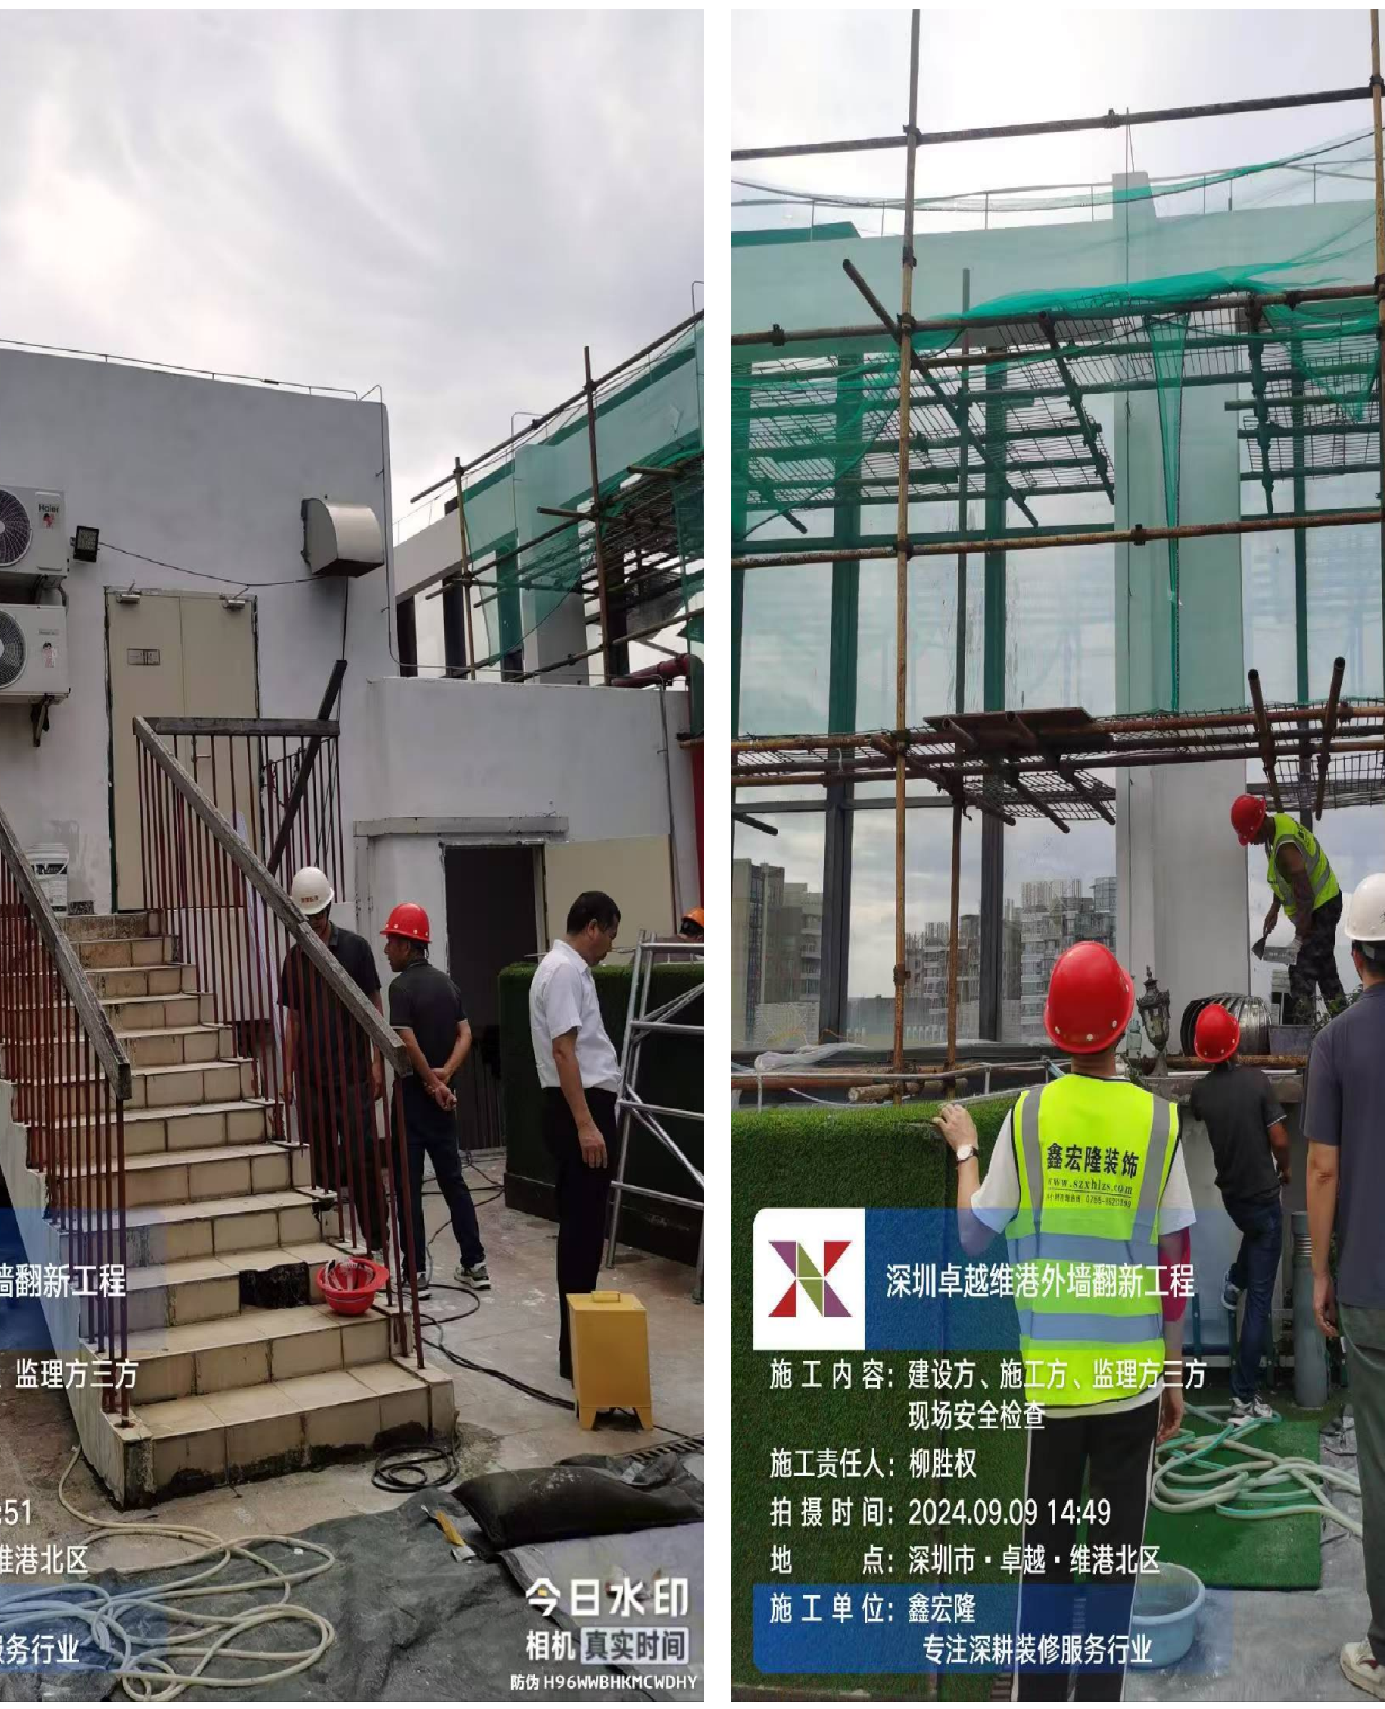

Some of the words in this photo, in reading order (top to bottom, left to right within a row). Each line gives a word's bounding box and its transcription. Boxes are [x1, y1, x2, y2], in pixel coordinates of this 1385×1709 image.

[1047, 1142, 1139, 1178] 鑫宏隆装饰
